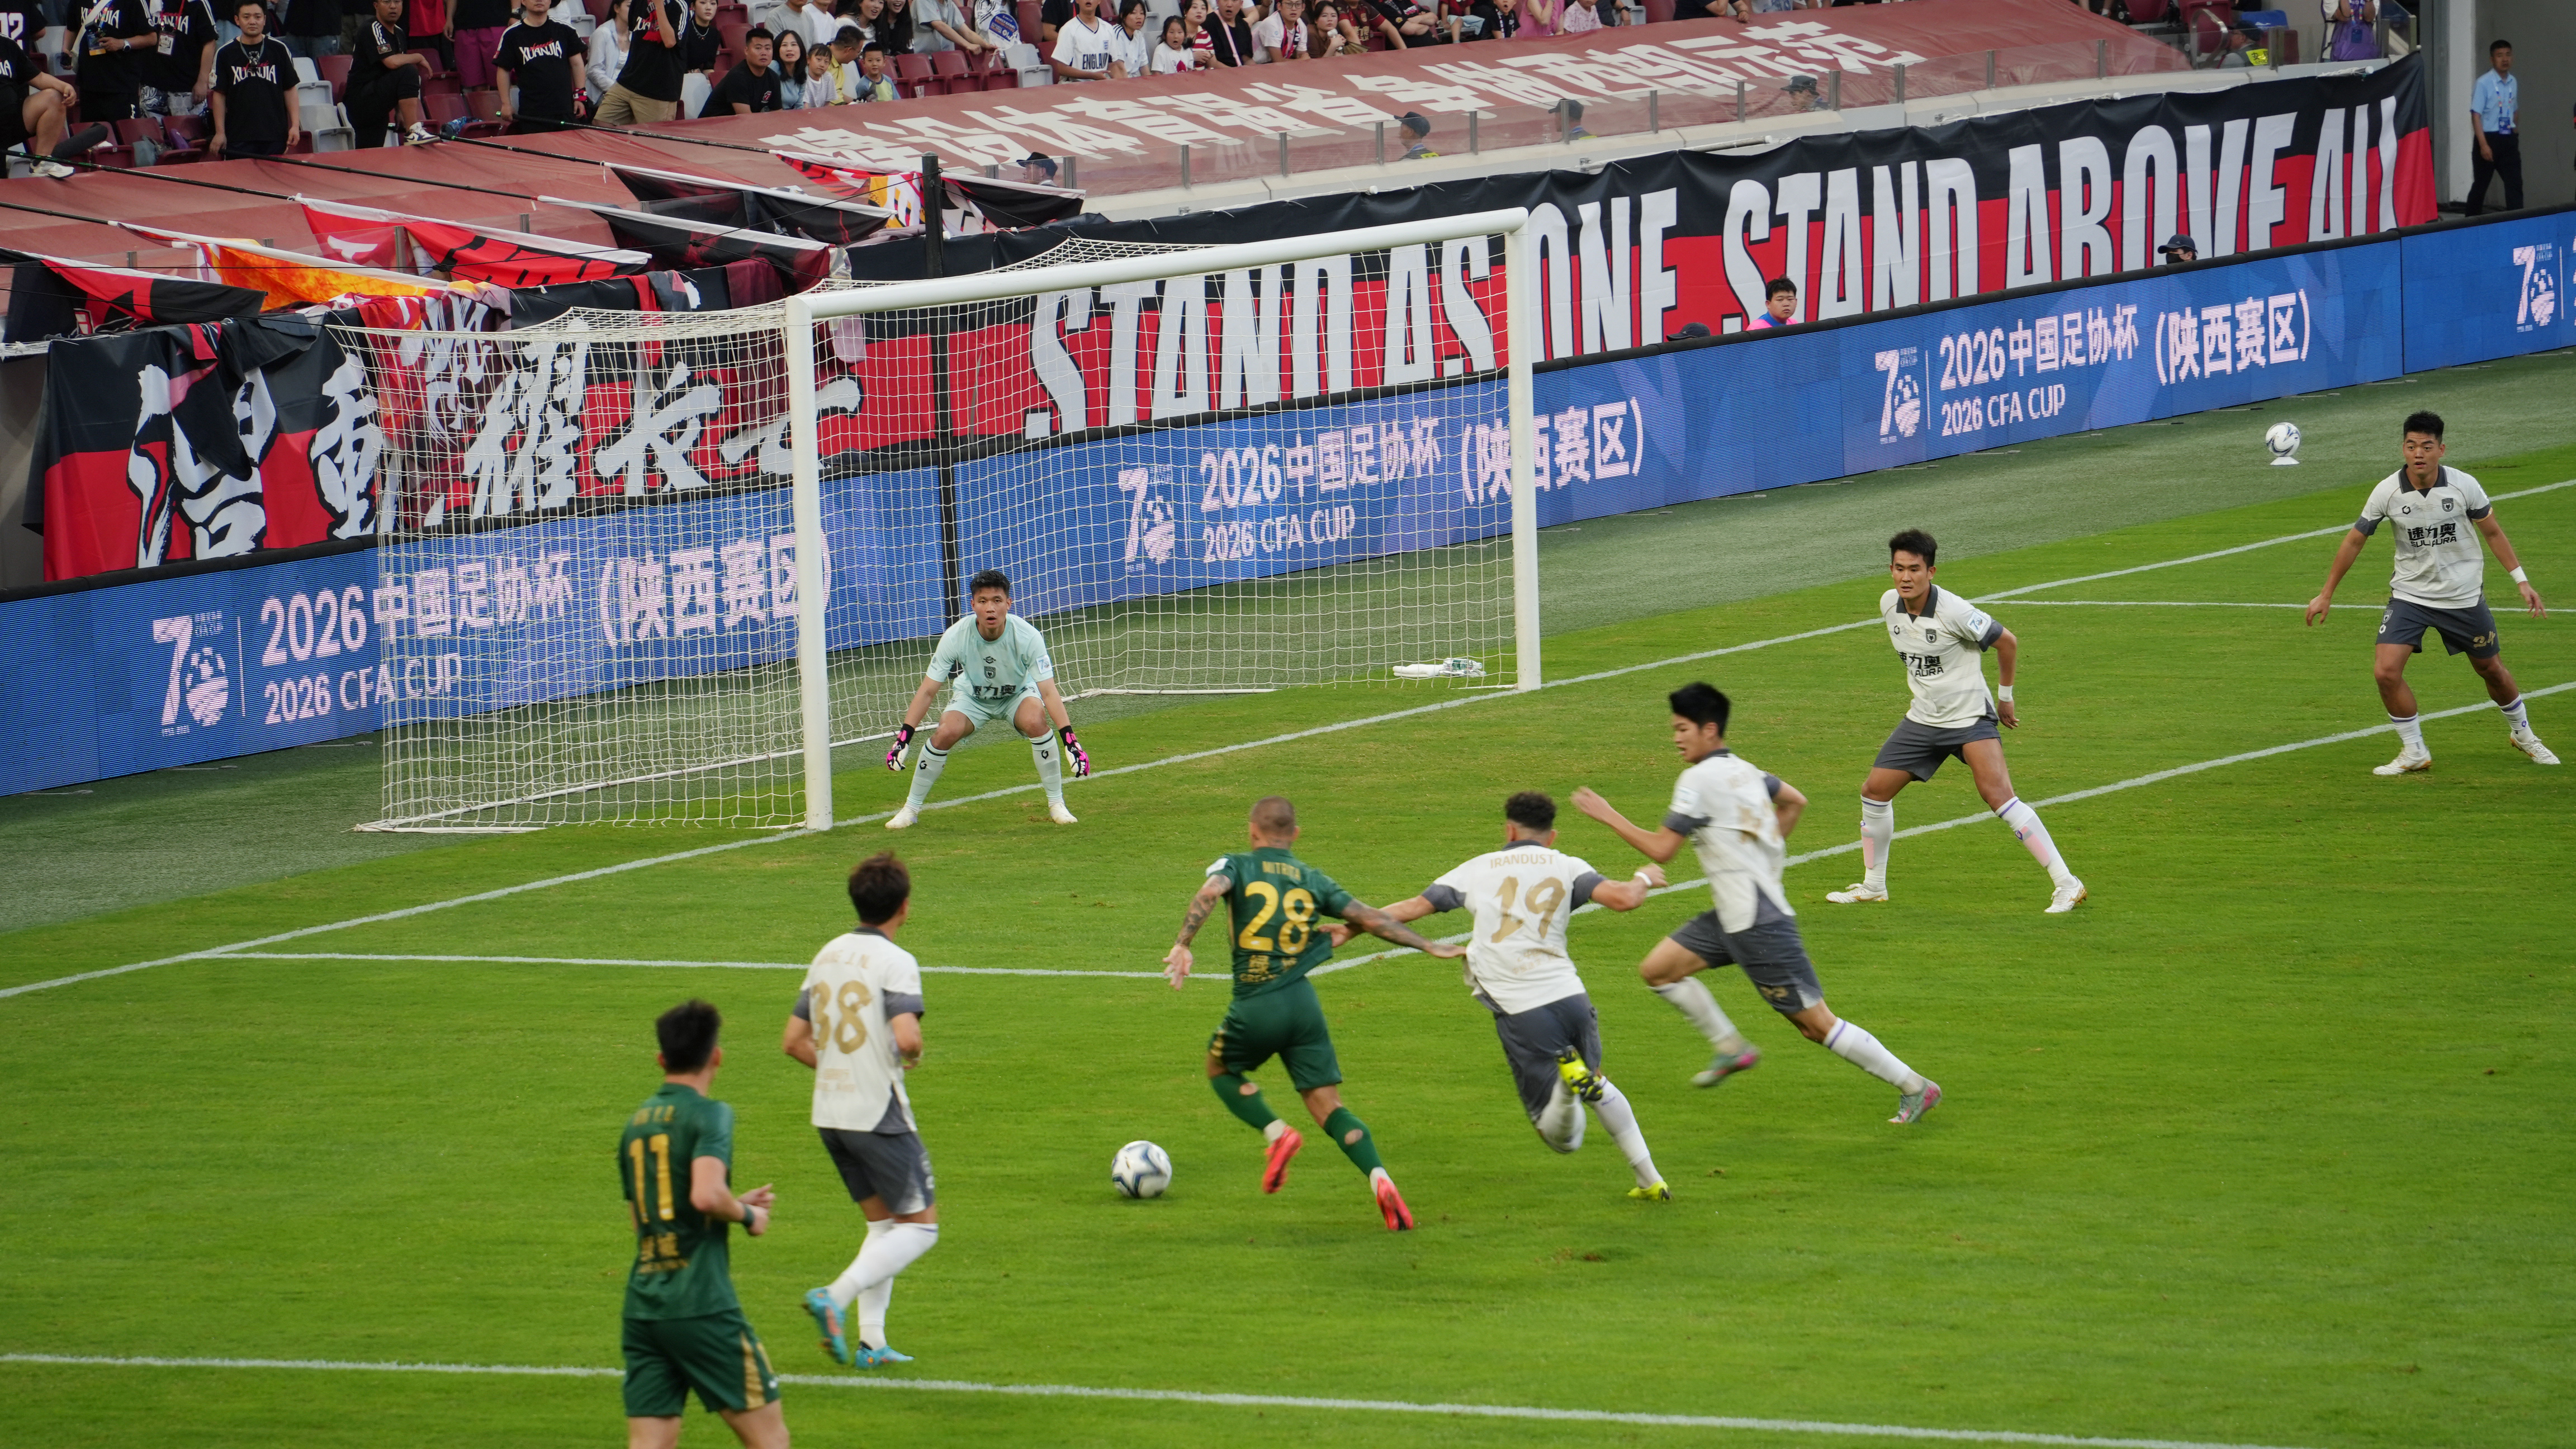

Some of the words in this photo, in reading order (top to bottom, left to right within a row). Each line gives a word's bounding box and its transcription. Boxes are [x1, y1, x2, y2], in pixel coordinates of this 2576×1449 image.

[81, 7, 120, 29] XUJIA
[148, 15, 189, 36] UANJIA
[519, 40, 562, 65] XUANJIA
[1082, 53, 1109, 70] ENGLAN
[231, 64, 277, 86] XUANJIA
[1025, 254, 1352, 439] STAND
[1384, 235, 1497, 386] AS
[1528, 188, 1677, 363] ONE
[1722, 158, 1980, 334] STAND
[2006, 112, 2298, 289] ABOVE
[1942, 396, 1983, 437] 2026
[1987, 391, 2023, 427] CFA
[2028, 383, 2066, 419] CUP
[1202, 518, 1254, 564] 2026
[1260, 513, 1303, 553] CFA
[1310, 505, 1355, 544] CUP
[2407, 523, 2456, 541] 速力奥
[2473, 631, 2496, 648] 24
[264, 675, 332, 724] 2026
[339, 664, 396, 711] CFA
[404, 652, 462, 698] CUP
[1490, 854, 1554, 869] IRANDUST
[1238, 880, 1315, 955] 28
[1491, 875, 1565, 943] 19
[812, 979, 872, 1054] 38
[629, 1133, 675, 1224] 11
